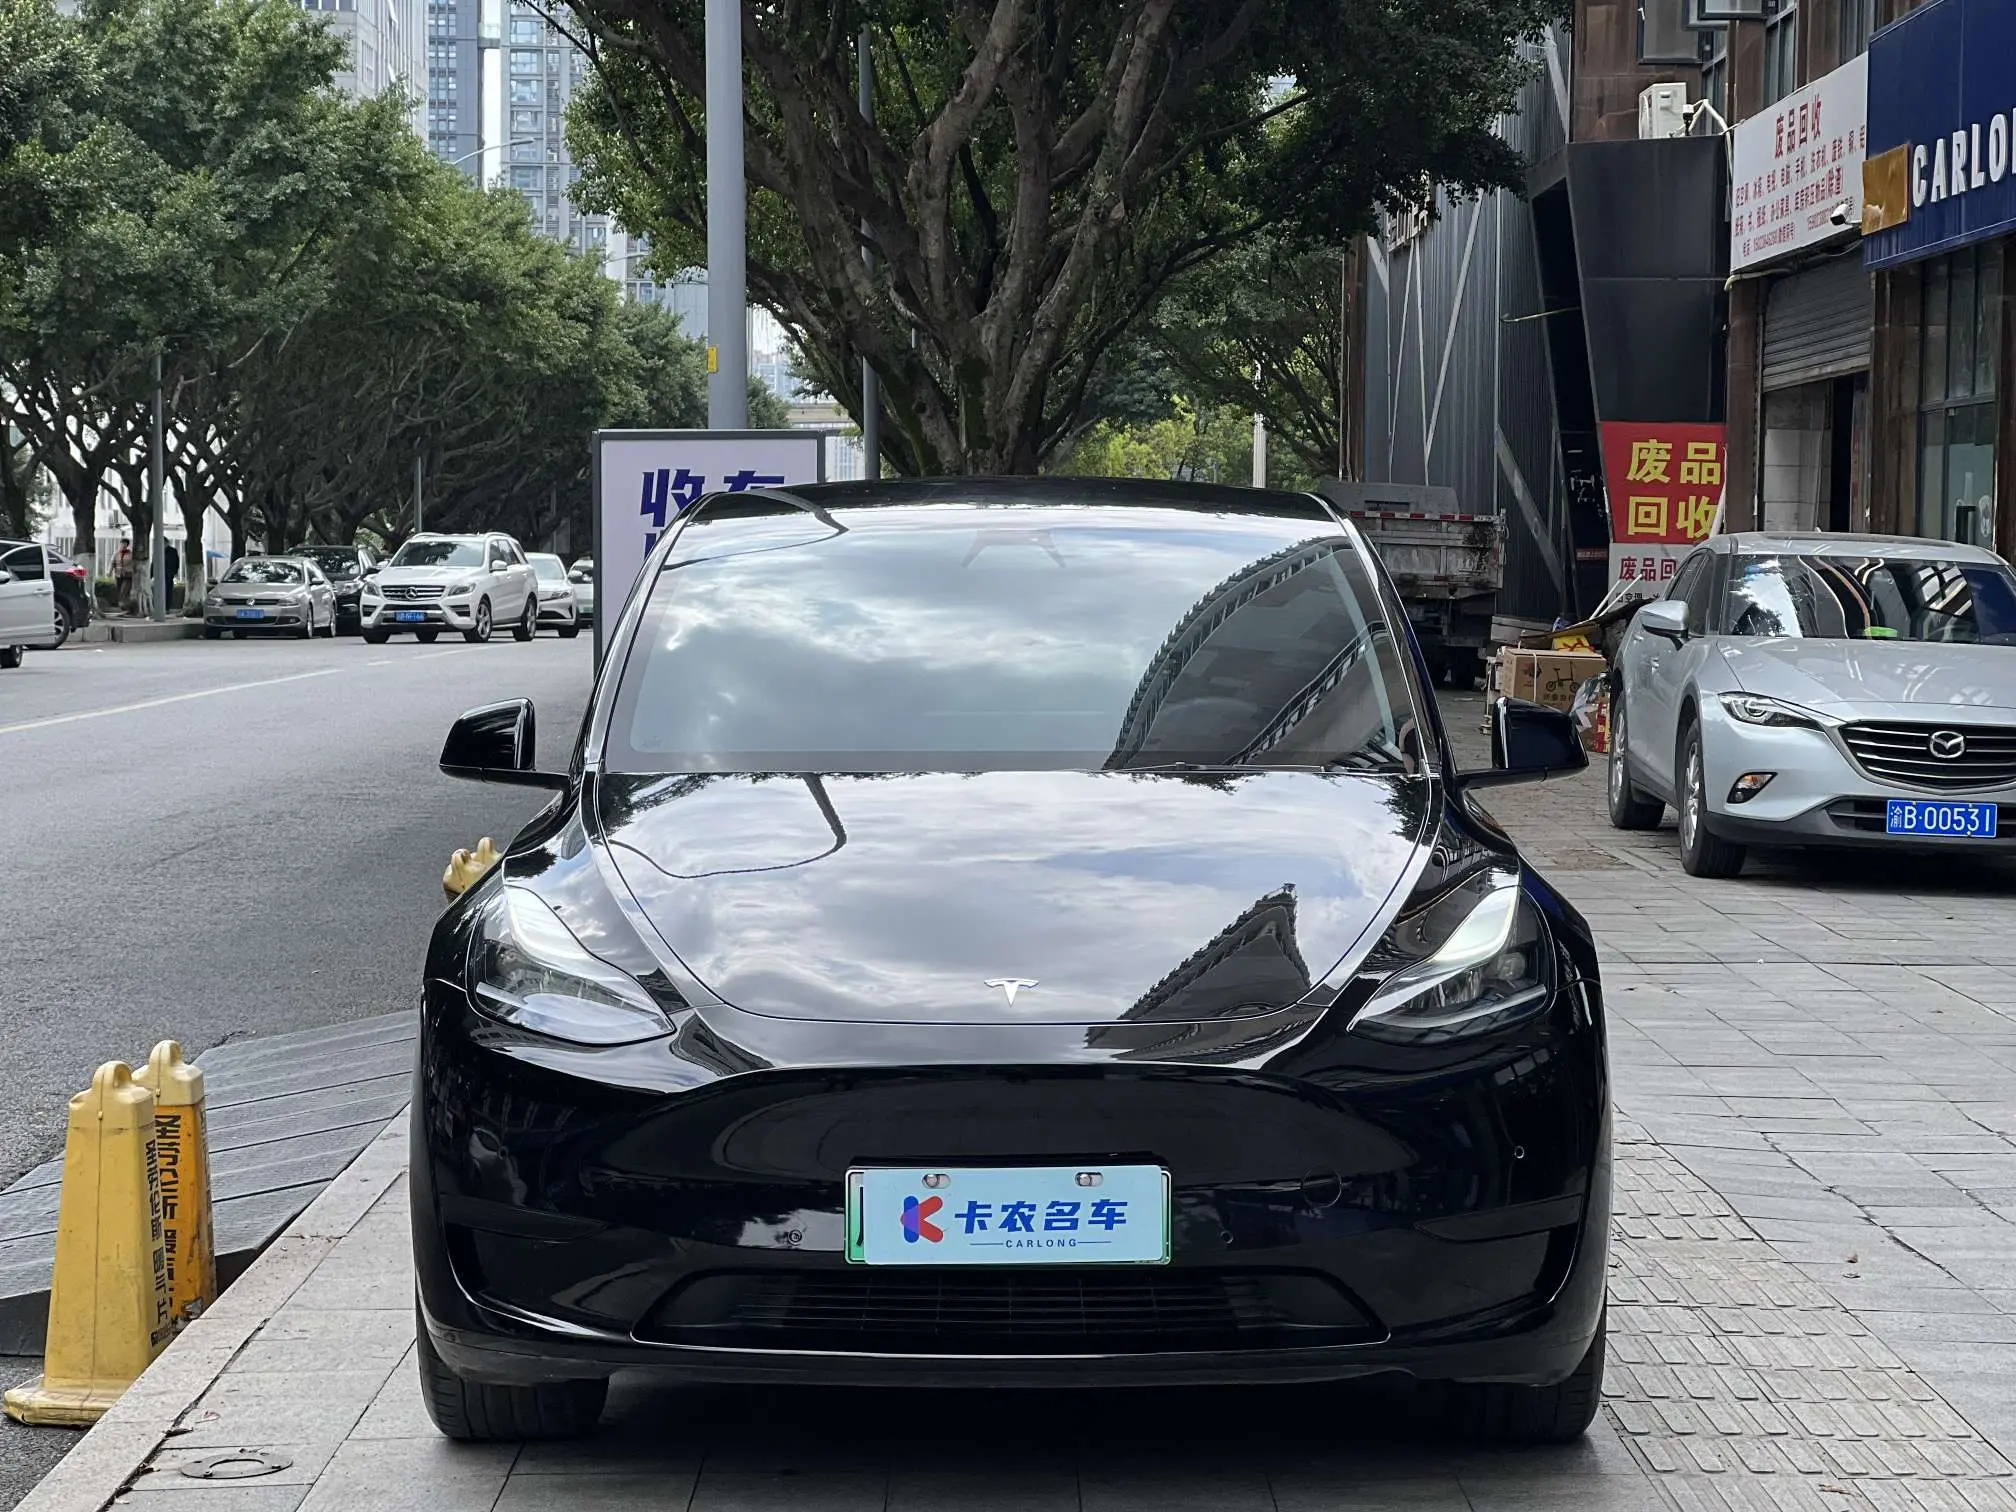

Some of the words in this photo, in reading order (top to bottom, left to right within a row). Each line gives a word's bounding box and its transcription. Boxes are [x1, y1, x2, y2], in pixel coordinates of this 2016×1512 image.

[1774, 94, 1822, 159] 废品回收
[1912, 107, 2016, 208] CARLO
[1626, 439, 1721, 485] 废品
[1627, 495, 1718, 539] 回收
[1619, 556, 1677, 581] 废品回
[954, 1199, 1128, 1234] 卡农名车
[1005, 1238, 1077, 1248] CARLONG
